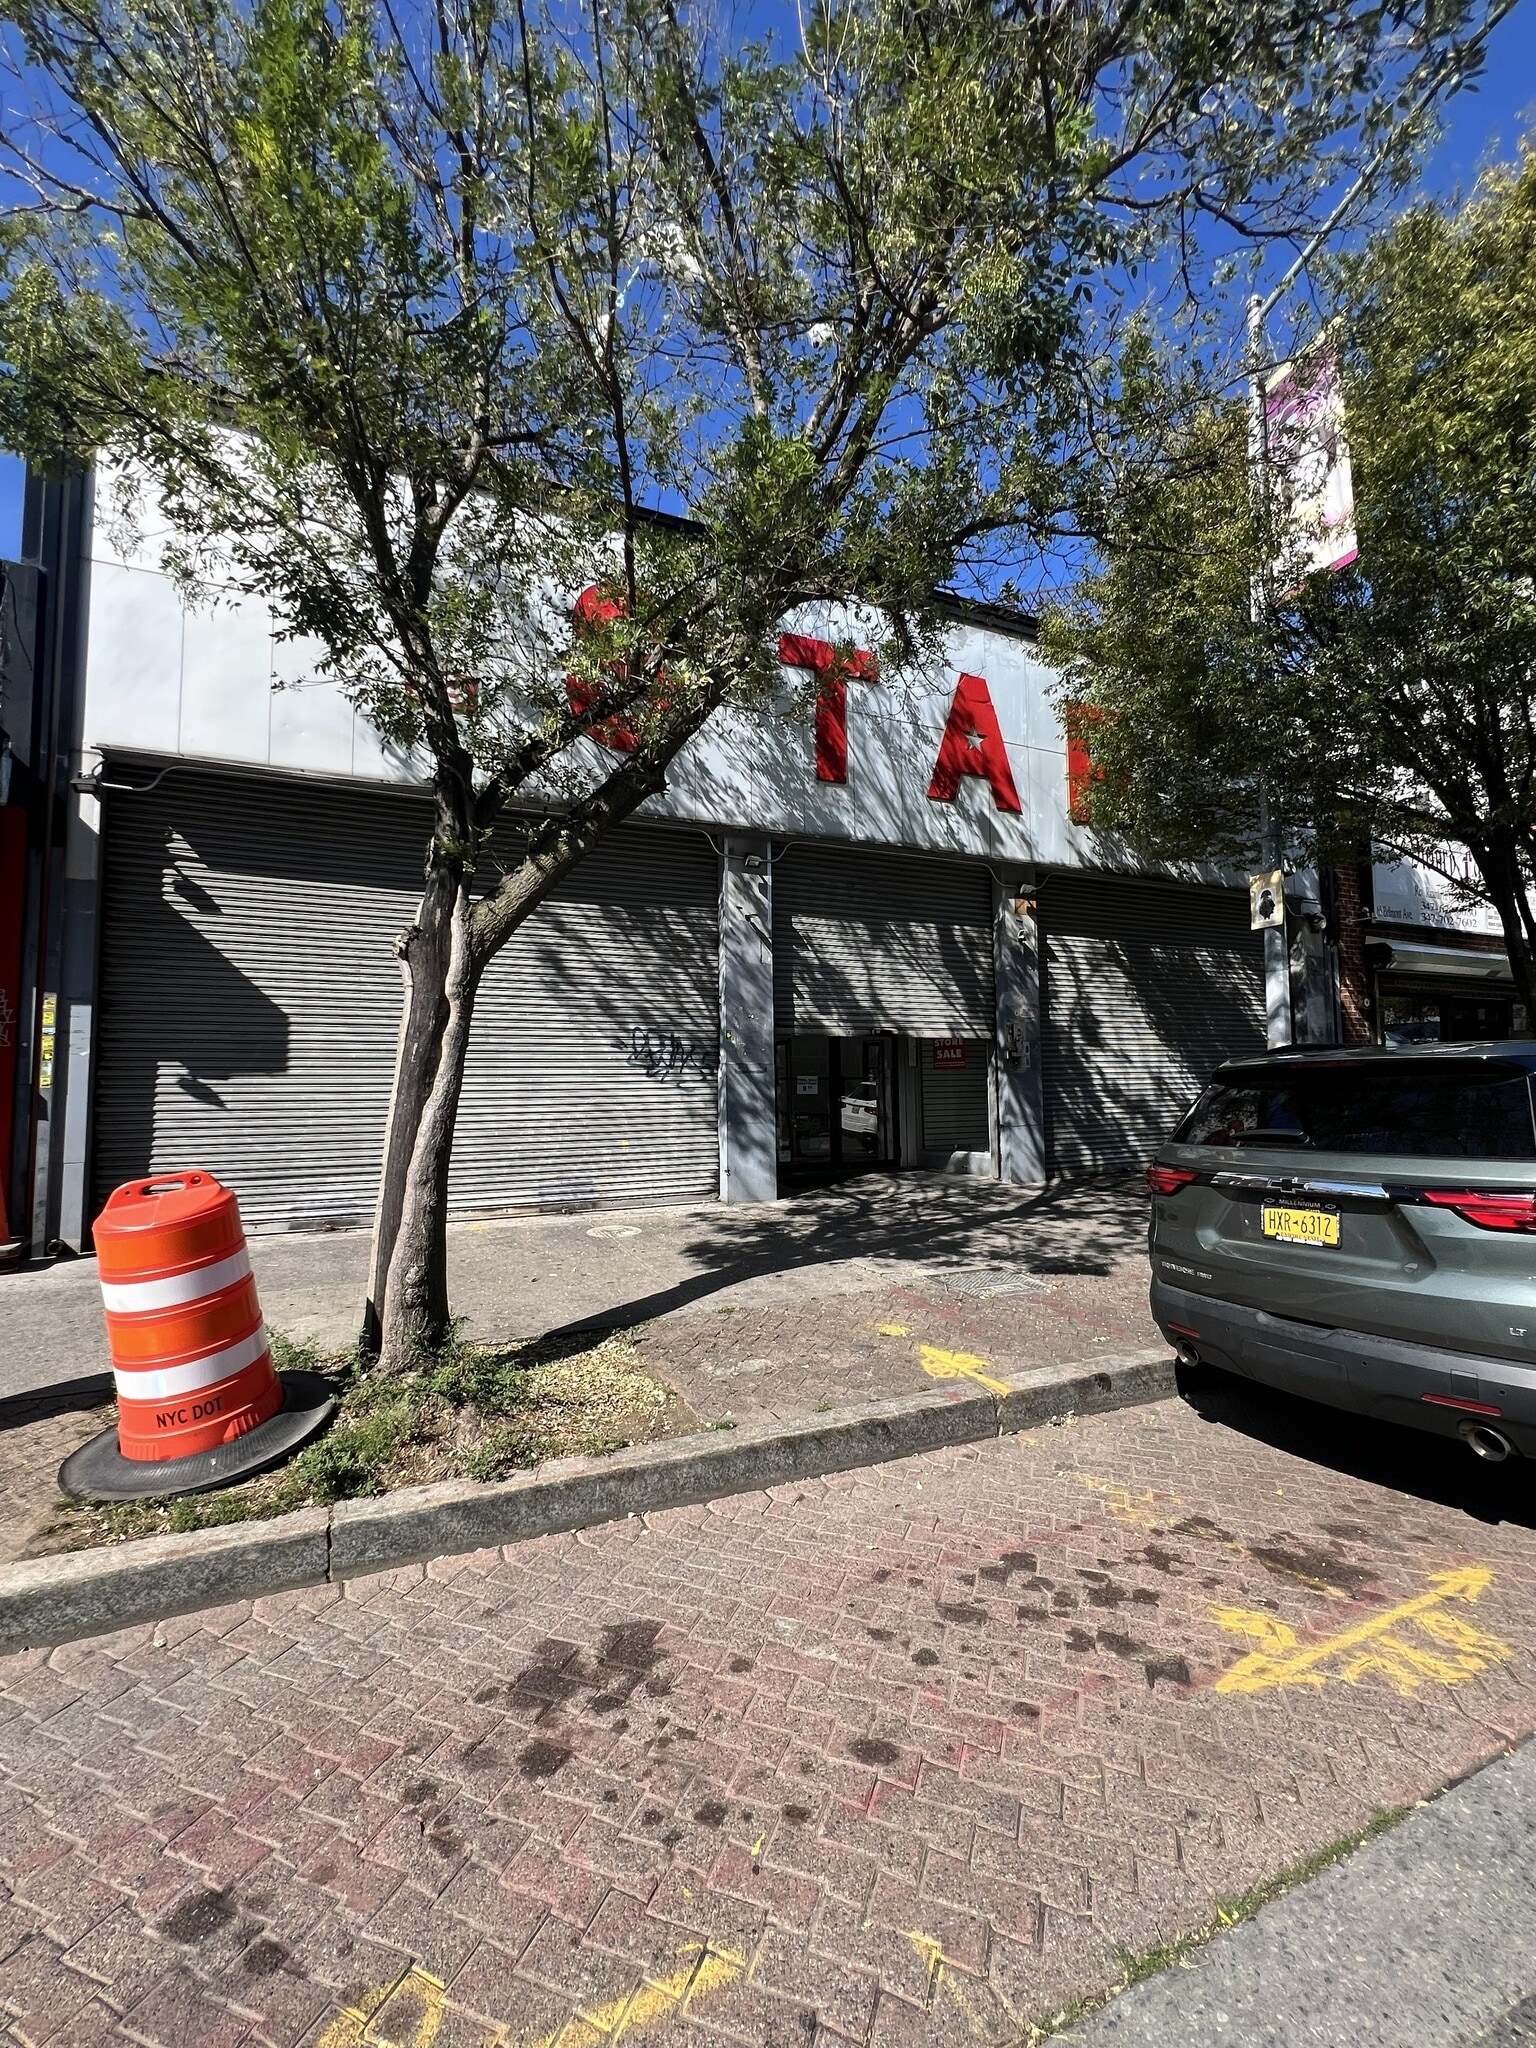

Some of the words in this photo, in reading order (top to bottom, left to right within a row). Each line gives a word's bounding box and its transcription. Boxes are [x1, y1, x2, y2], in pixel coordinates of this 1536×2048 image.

[934, 1038, 964, 1047] STORE
[936, 1048, 962, 1059] SALE
[1278, 1198, 1321, 1208] MILLENNIUM
[1509, 1327, 1527, 1337] LT
[156, 1409, 188, 1429] NYC
[192, 1396, 224, 1421] DOT
